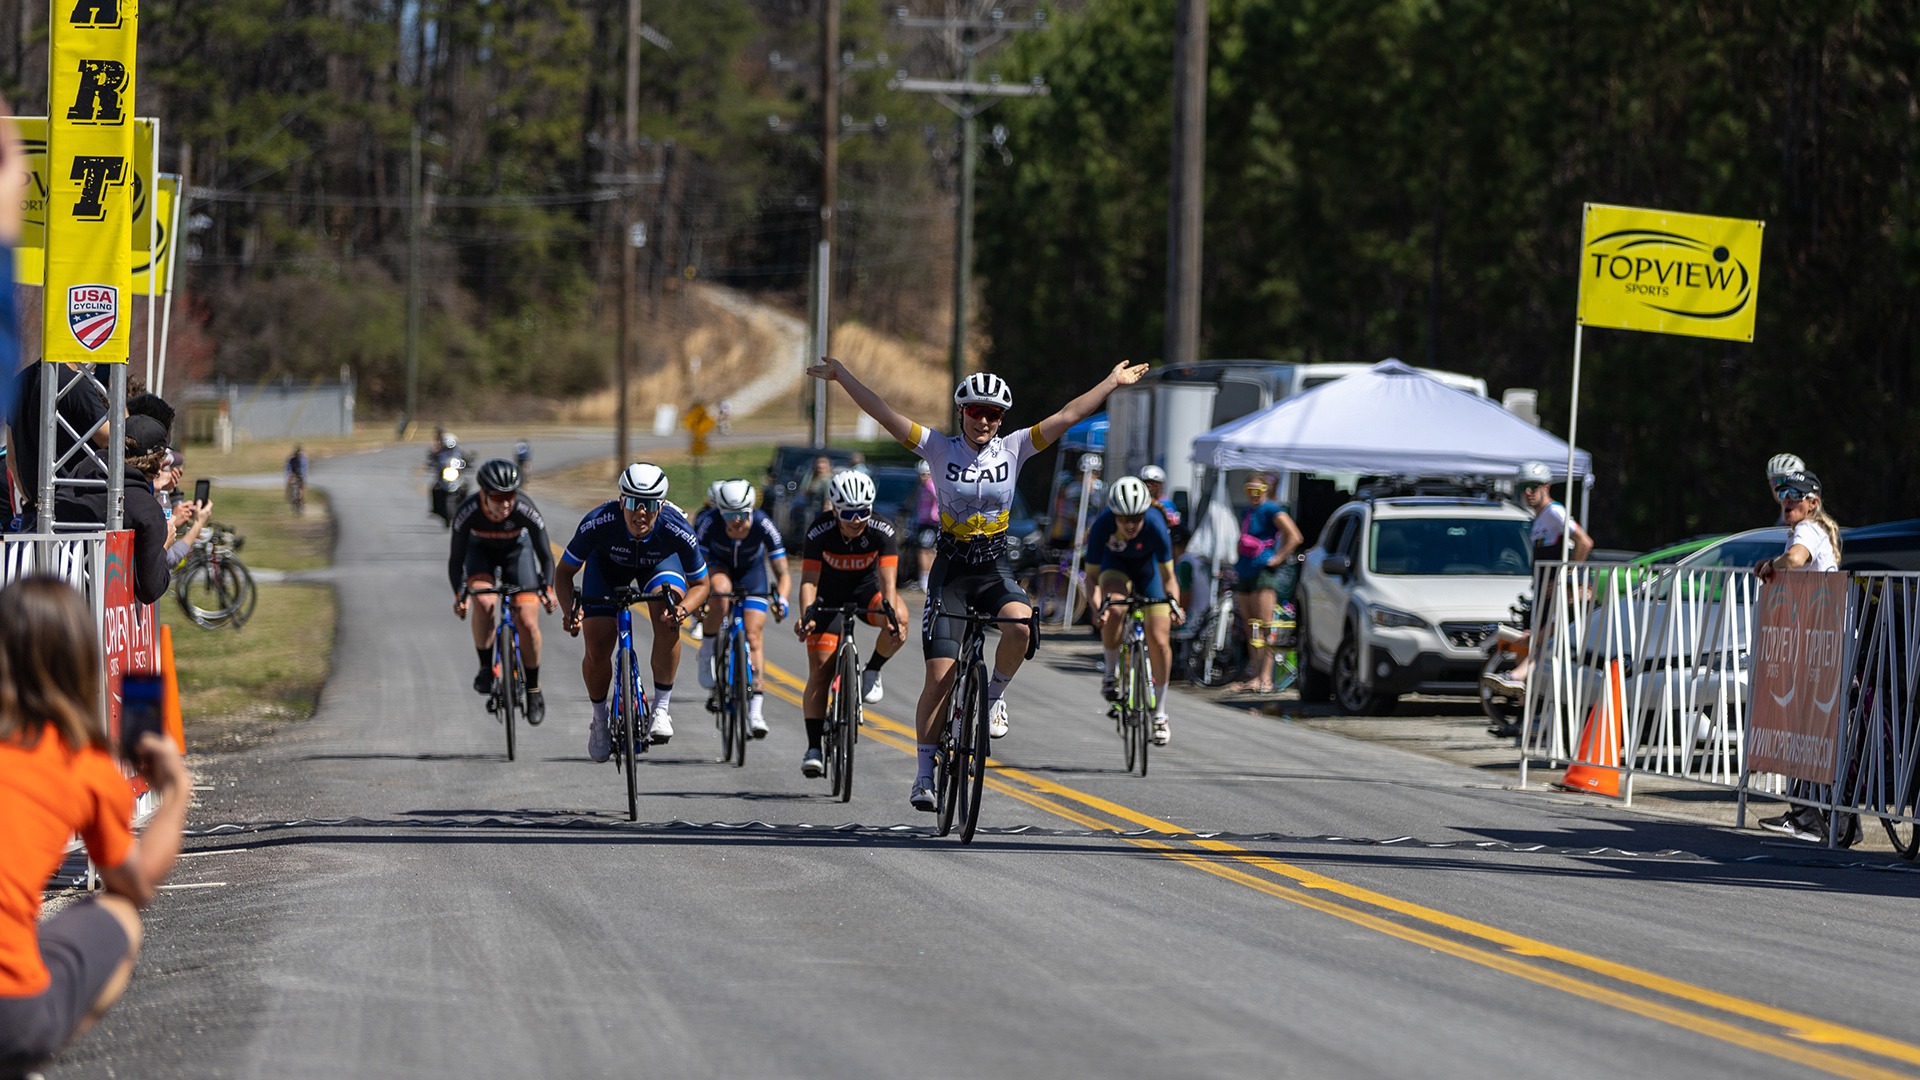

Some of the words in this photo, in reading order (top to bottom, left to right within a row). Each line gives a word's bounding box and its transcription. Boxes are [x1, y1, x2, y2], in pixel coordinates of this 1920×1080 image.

[1591, 253, 1735, 290] TOPVIEW
[74, 289, 112, 303] USA
[1624, 282, 1669, 296] SPORTS
[73, 303, 112, 311] CYCLING
[945, 461, 1009, 483] SCAD
[867, 519, 895, 538] ILLIGAN
